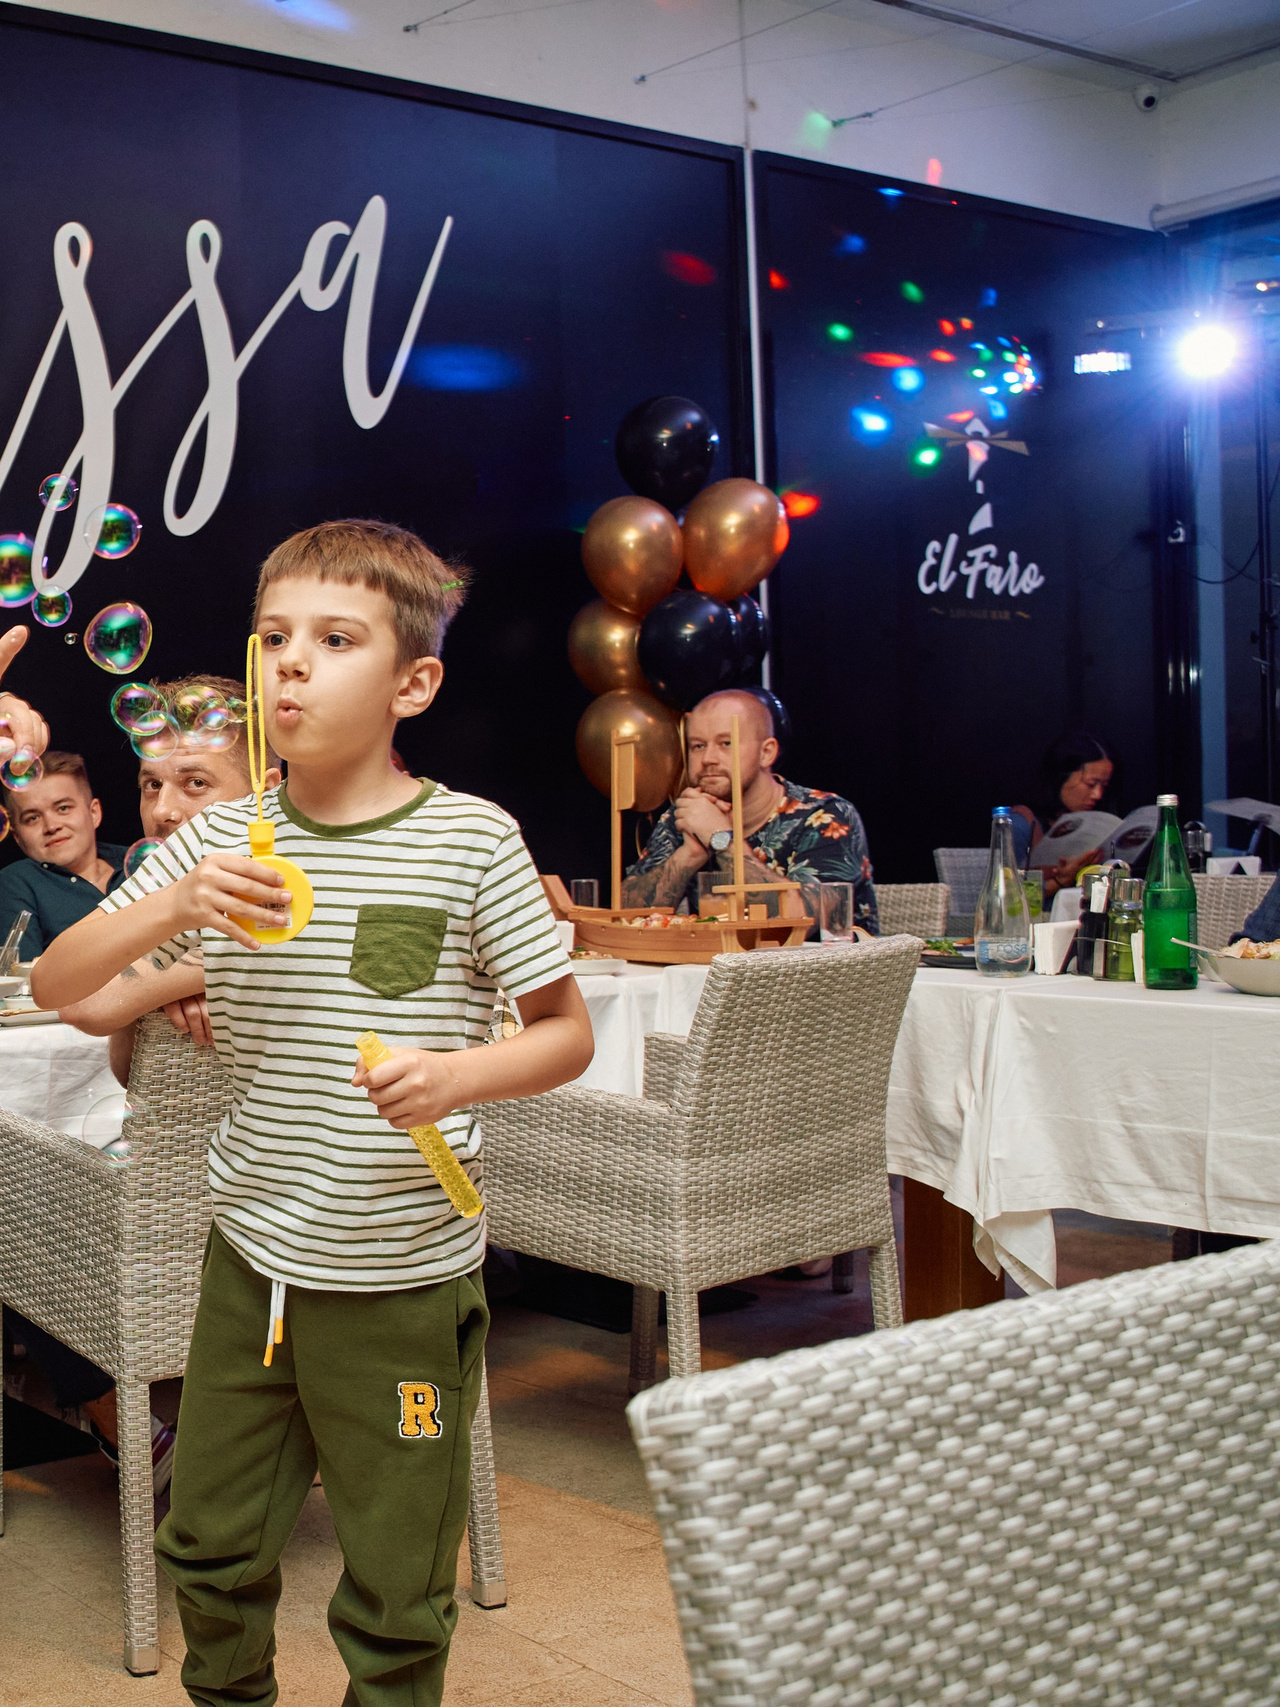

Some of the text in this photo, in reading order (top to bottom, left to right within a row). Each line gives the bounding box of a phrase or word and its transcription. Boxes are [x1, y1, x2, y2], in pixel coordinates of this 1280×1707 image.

[918, 533, 1045, 599] El Faro
[398, 1381, 443, 1438] R
